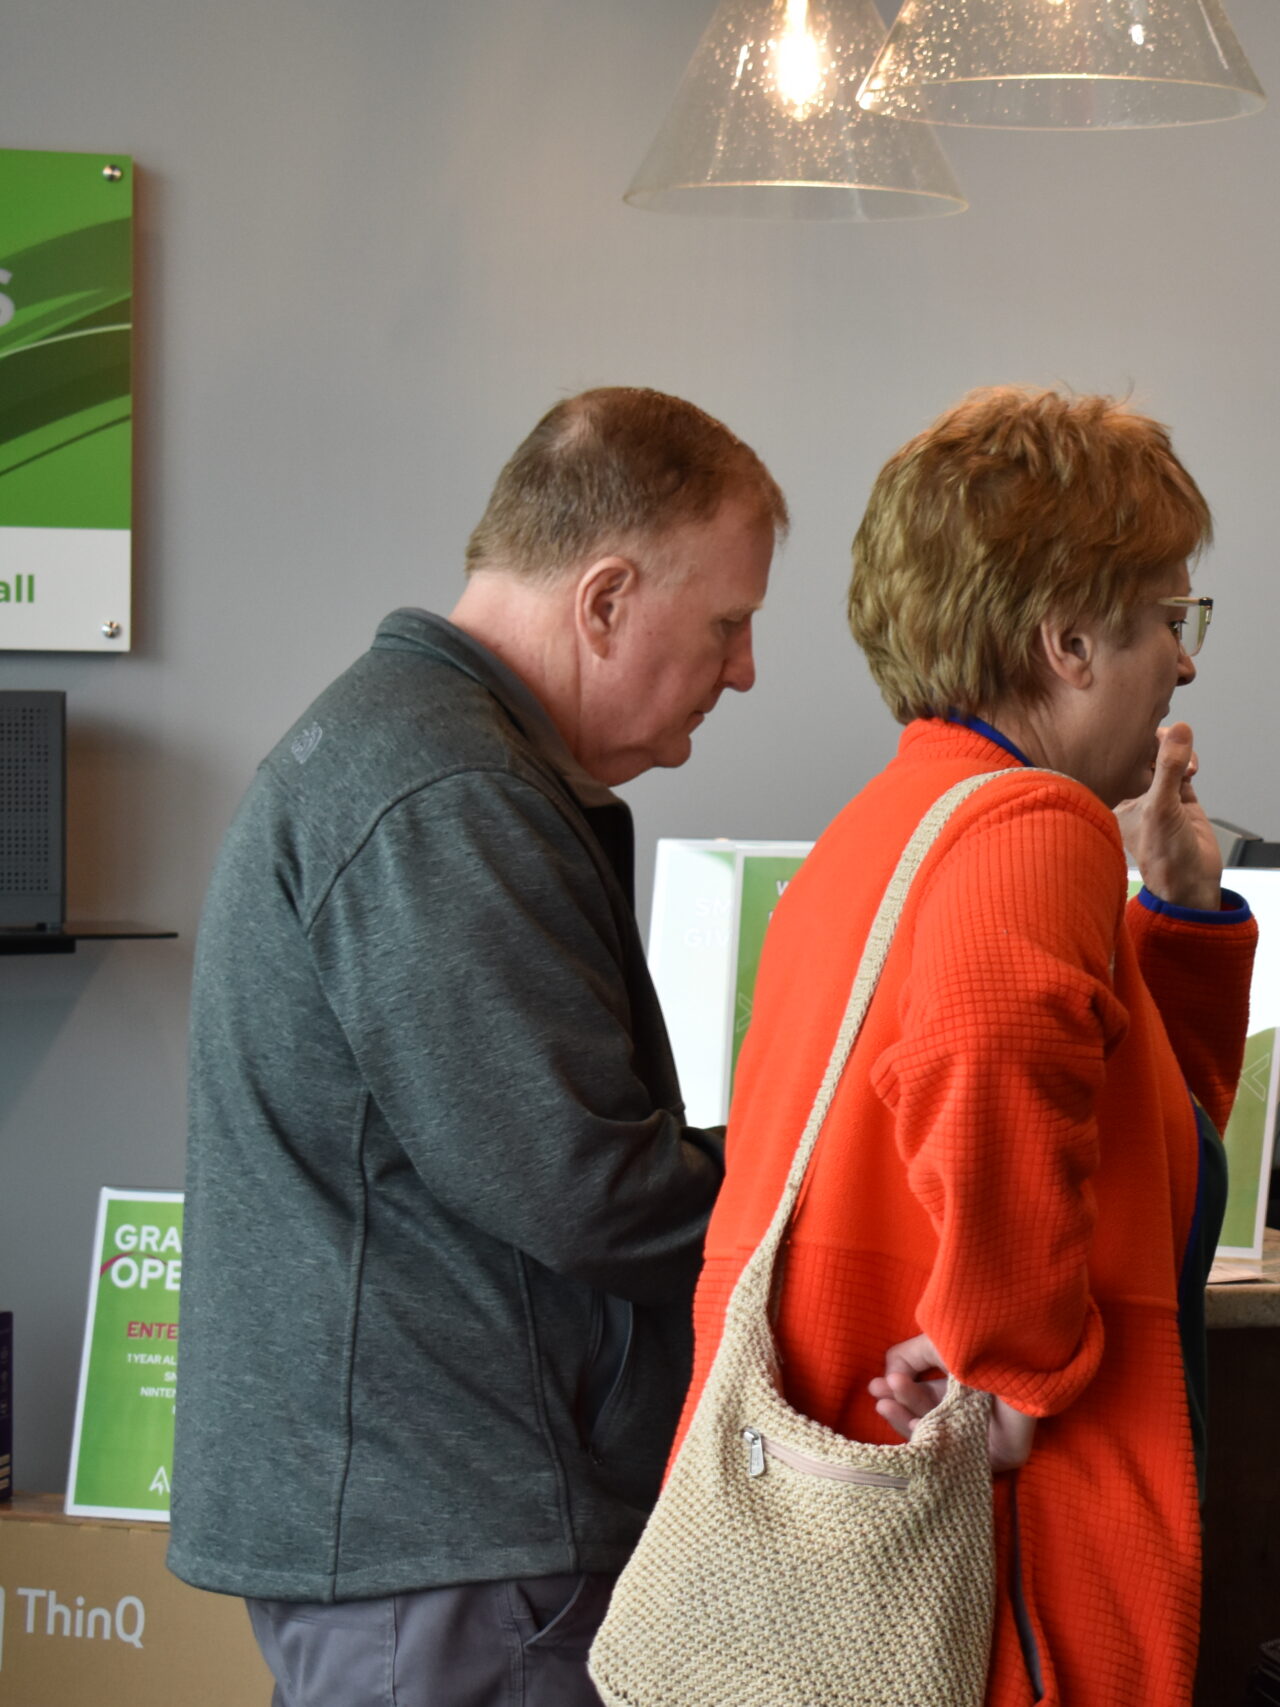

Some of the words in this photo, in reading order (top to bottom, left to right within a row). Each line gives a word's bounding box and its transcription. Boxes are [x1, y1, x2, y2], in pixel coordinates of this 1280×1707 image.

[114, 1223, 183, 1253] GRA
[111, 1256, 182, 1291] OPE
[127, 1321, 179, 1340] ENTE
[133, 1353, 161, 1365] YEAR
[16, 1587, 146, 1649] ThinQ
